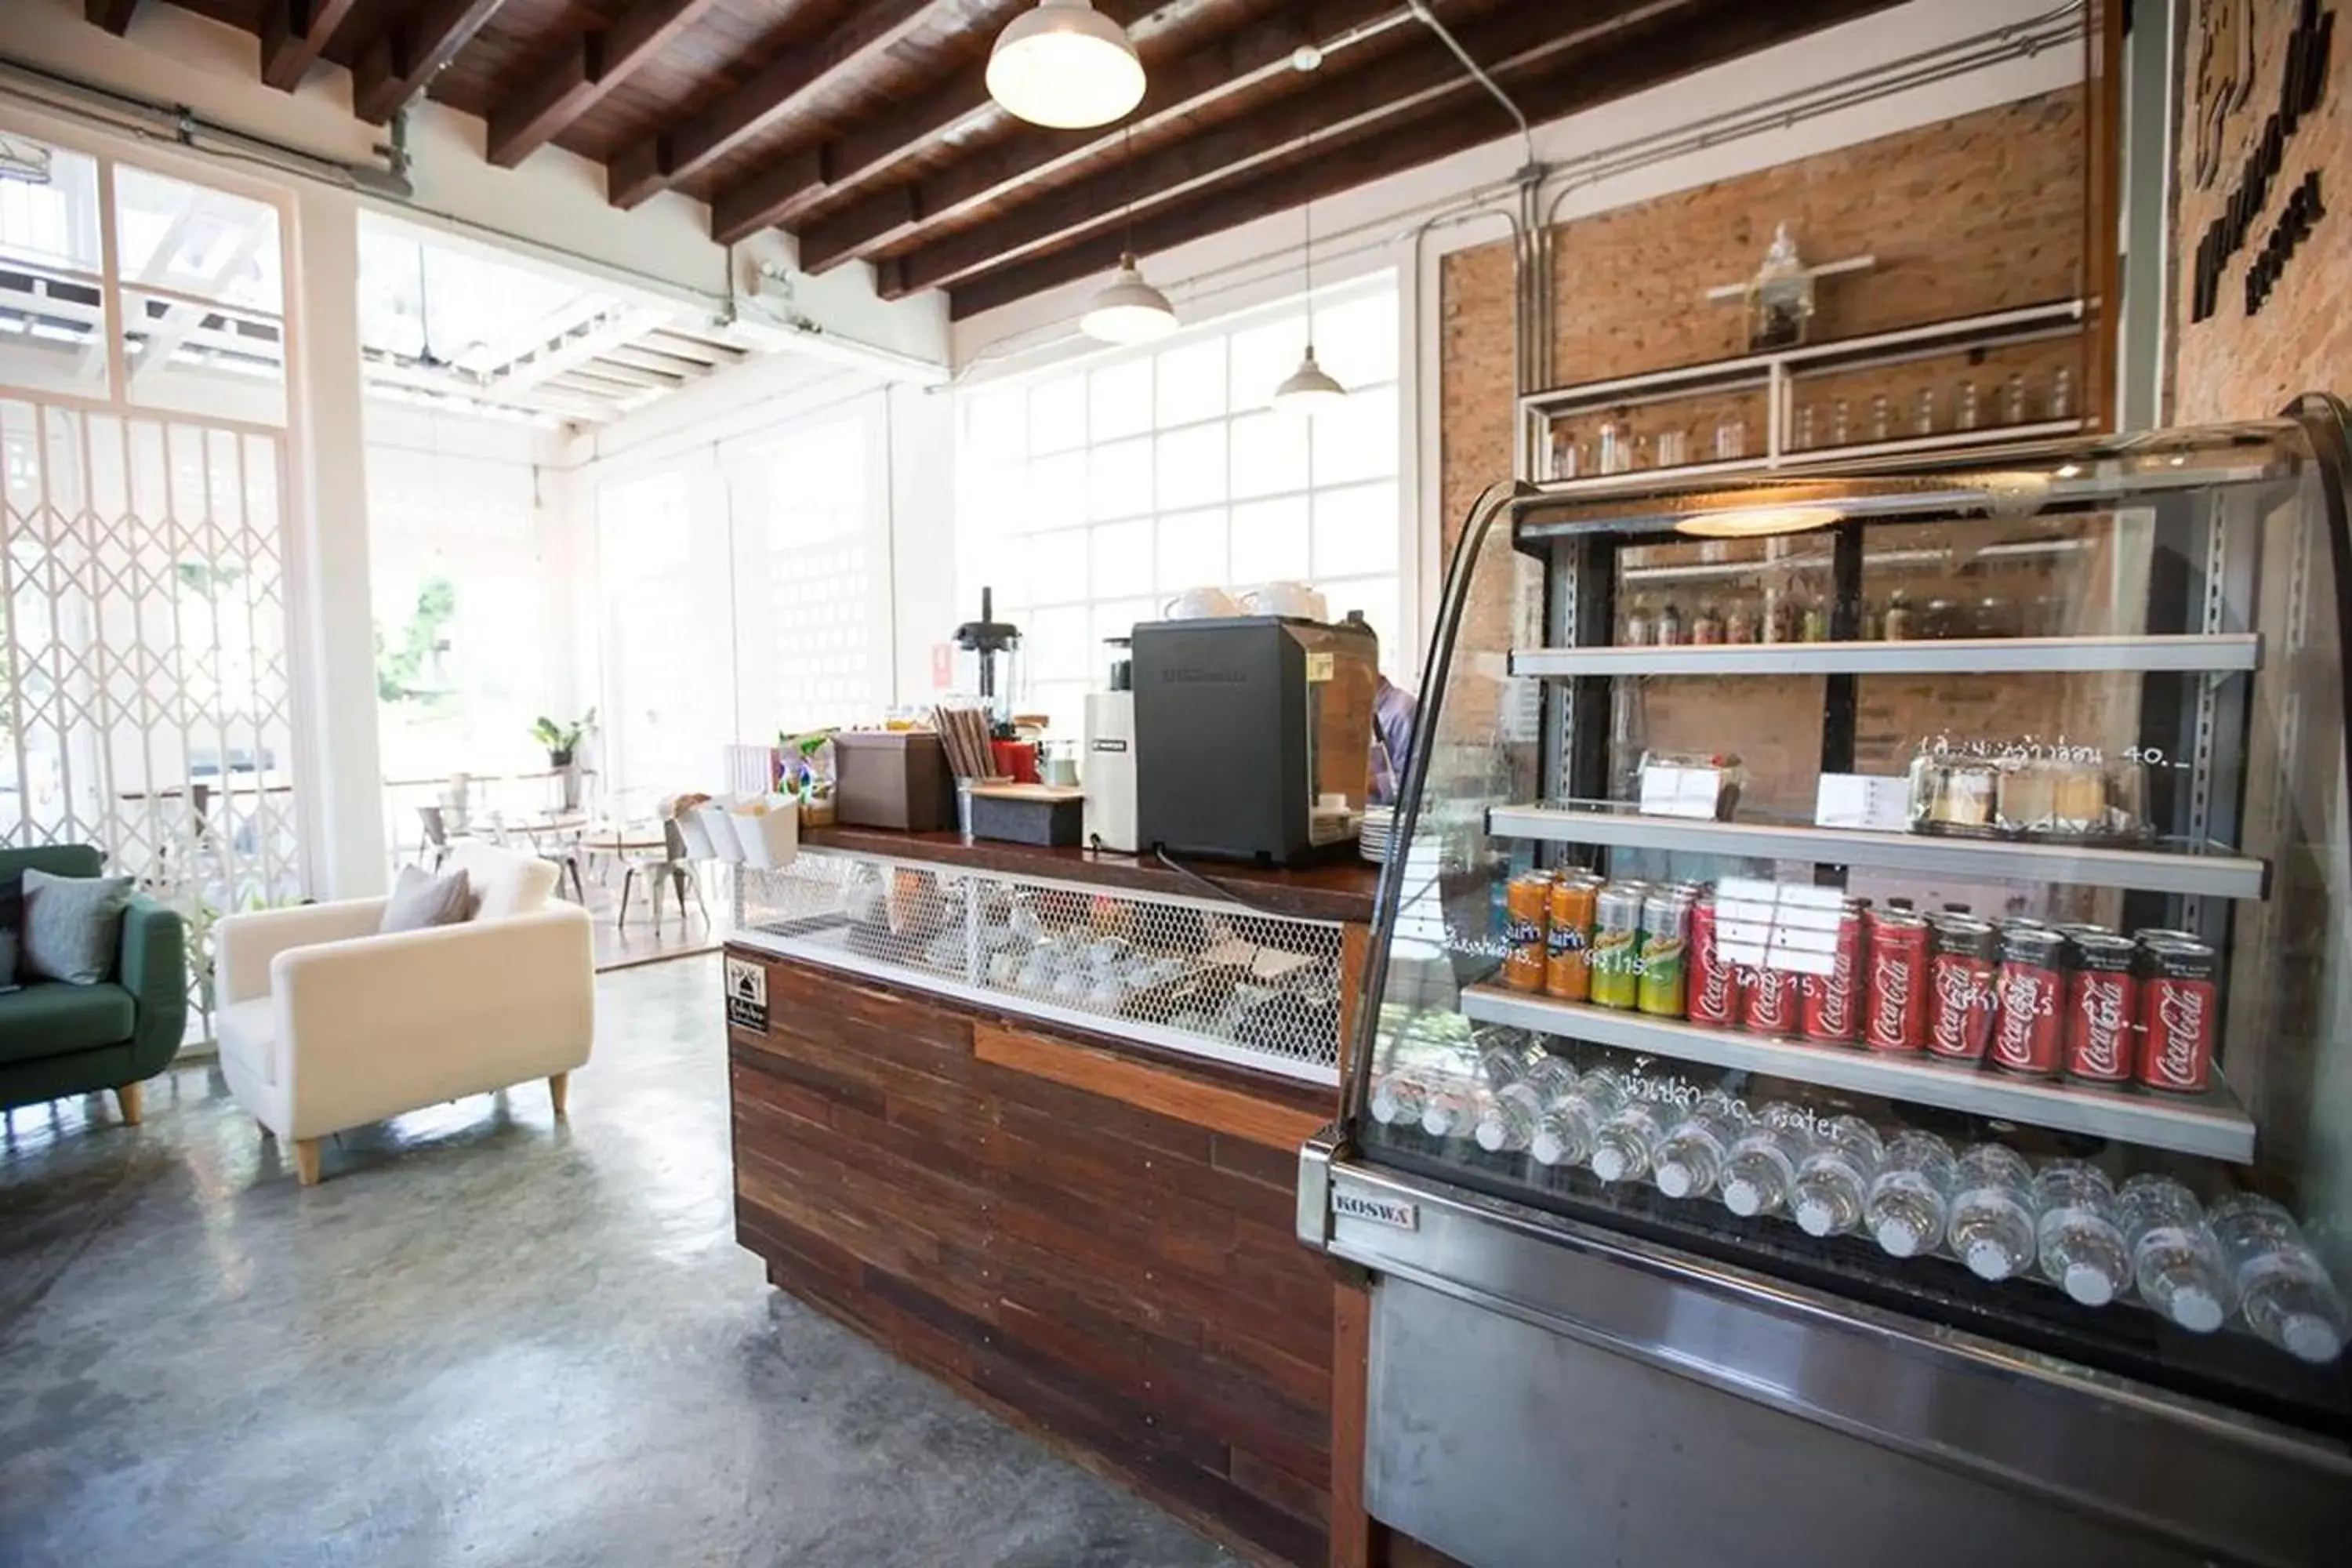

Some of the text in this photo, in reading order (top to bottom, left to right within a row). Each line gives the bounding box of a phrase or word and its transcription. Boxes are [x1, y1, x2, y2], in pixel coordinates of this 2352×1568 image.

[1873, 952, 1908, 1045] Coca-Cola
[2156, 981, 2202, 1085] Coca-Cola
[1335, 1193, 1410, 1225] KOSWA
